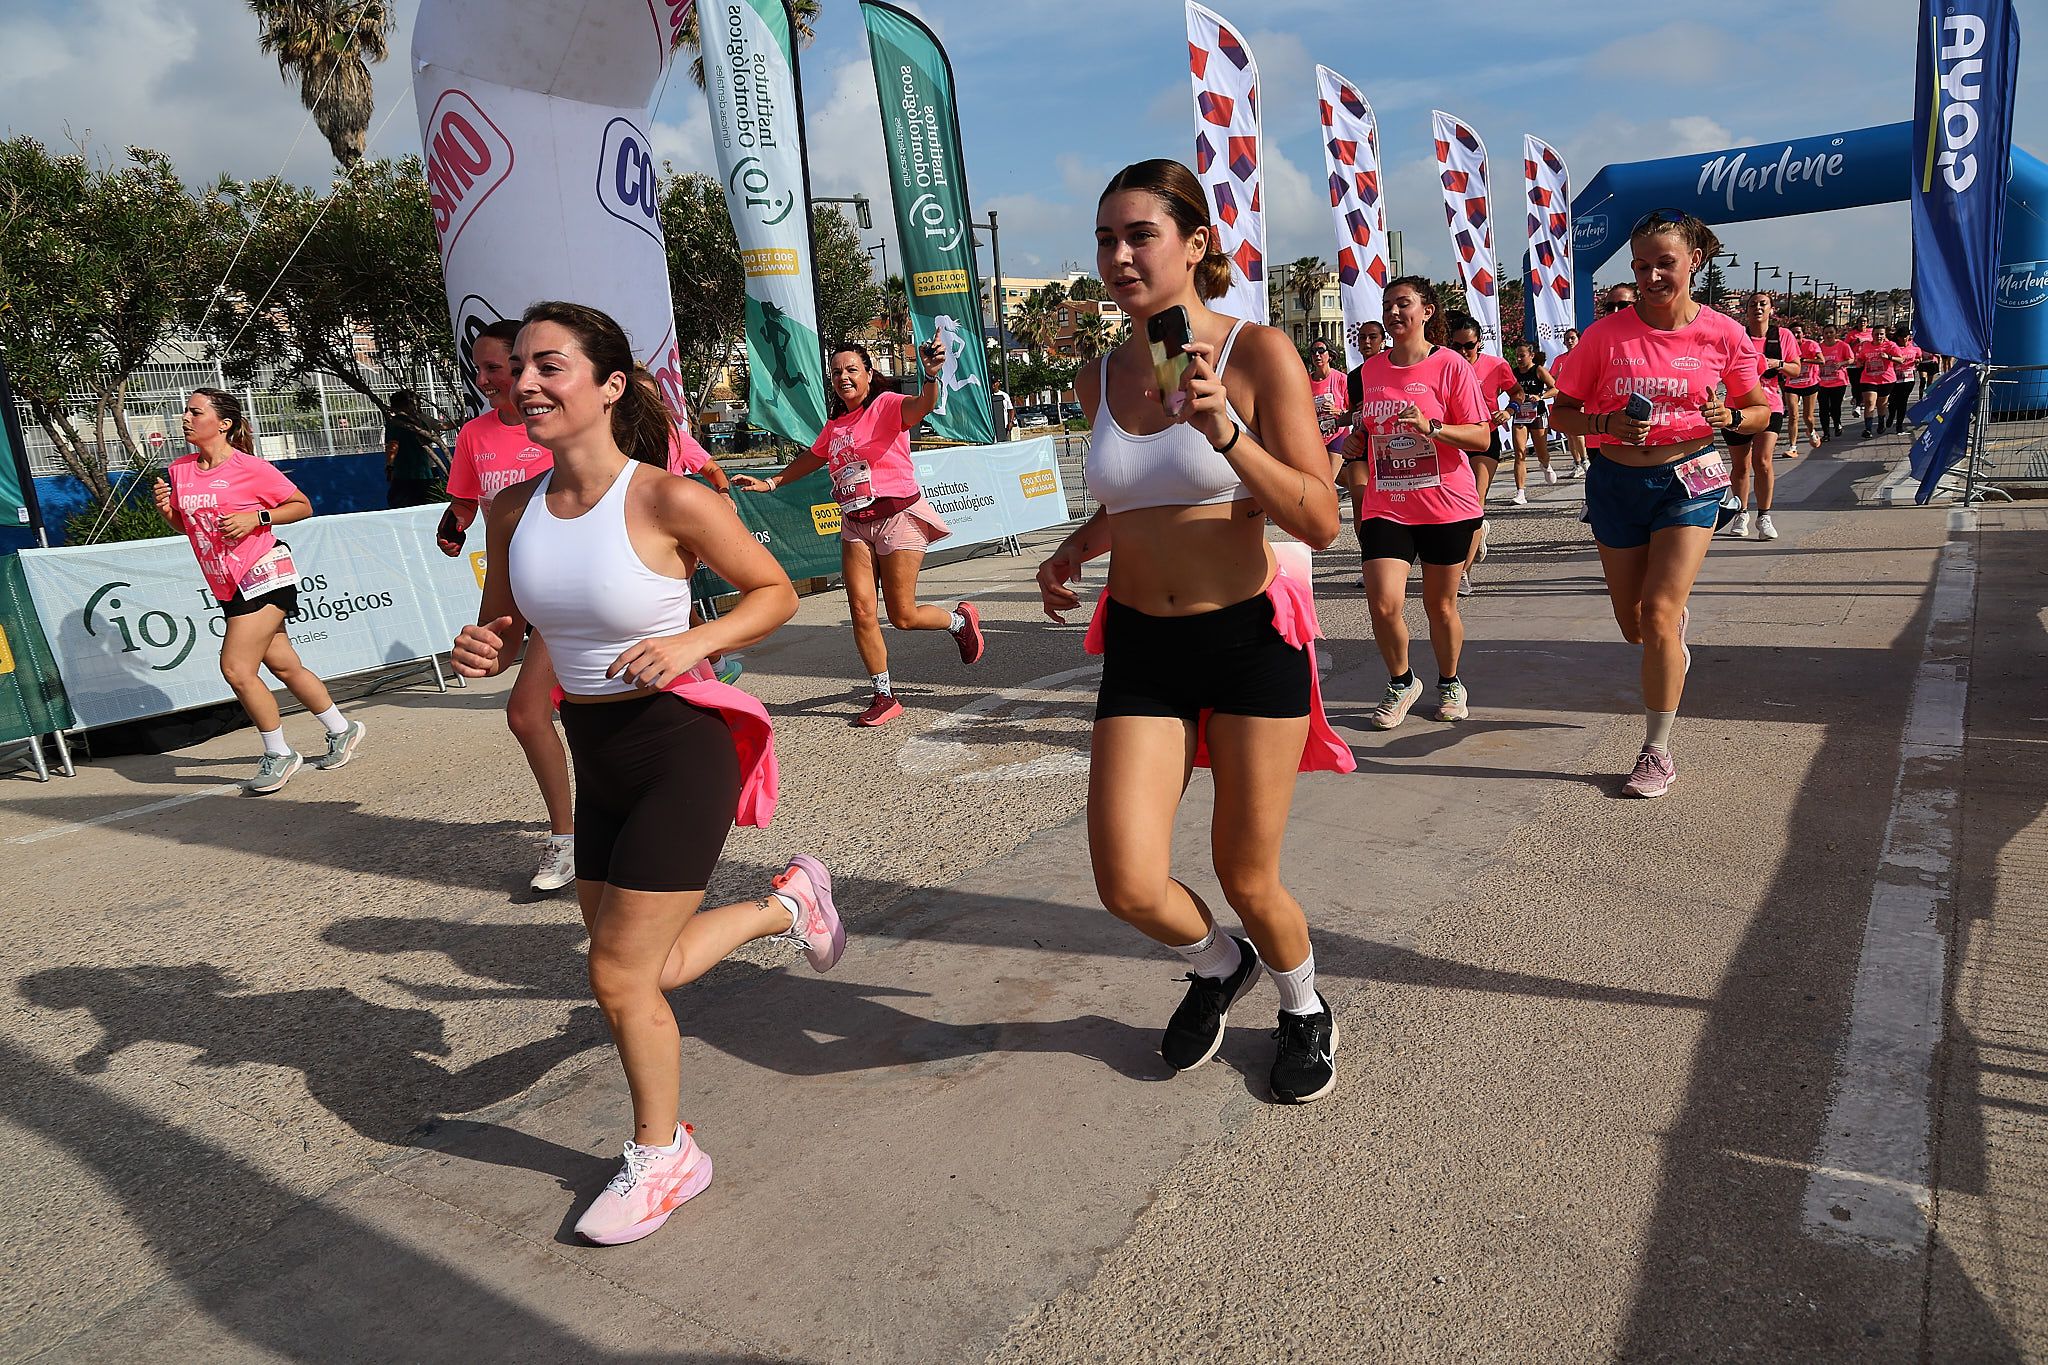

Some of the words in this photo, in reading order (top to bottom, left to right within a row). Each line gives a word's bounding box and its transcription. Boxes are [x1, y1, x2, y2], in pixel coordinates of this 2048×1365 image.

[1697, 145, 1843, 211] Marlene
[1612, 357, 1645, 366] OYSHO
[1392, 458, 1417, 469] 016
[841, 484, 856, 496] 016
[921, 481, 970, 499] Institutos
[814, 510, 832, 520] 900
[287, 631, 328, 646] ntales
